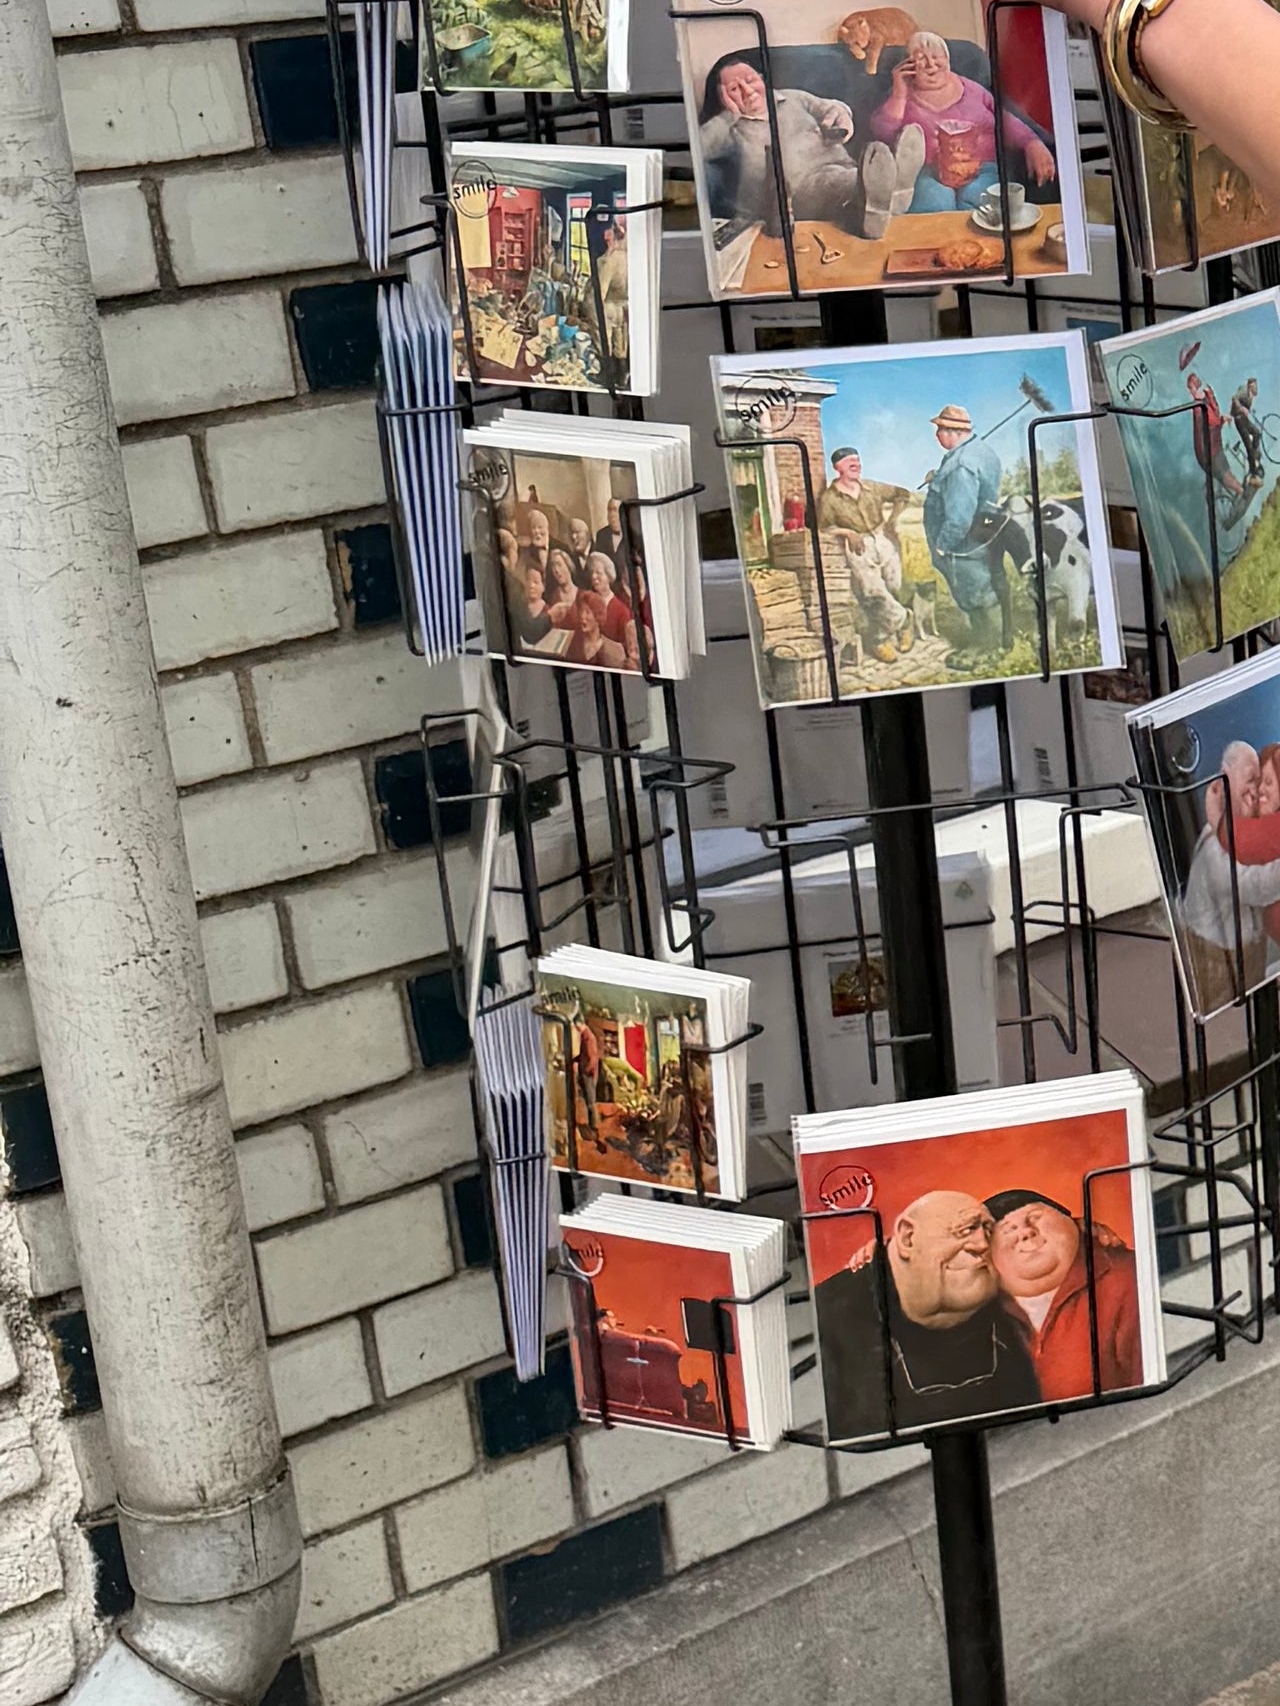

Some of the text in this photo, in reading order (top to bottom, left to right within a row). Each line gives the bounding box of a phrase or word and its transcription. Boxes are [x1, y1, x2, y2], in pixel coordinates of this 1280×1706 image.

[453, 175, 498, 200] smile
[1120, 362, 1148, 403] smile
[739, 386, 797, 423] smile
[469, 463, 508, 486] smile
[820, 1173, 872, 1205] smile
